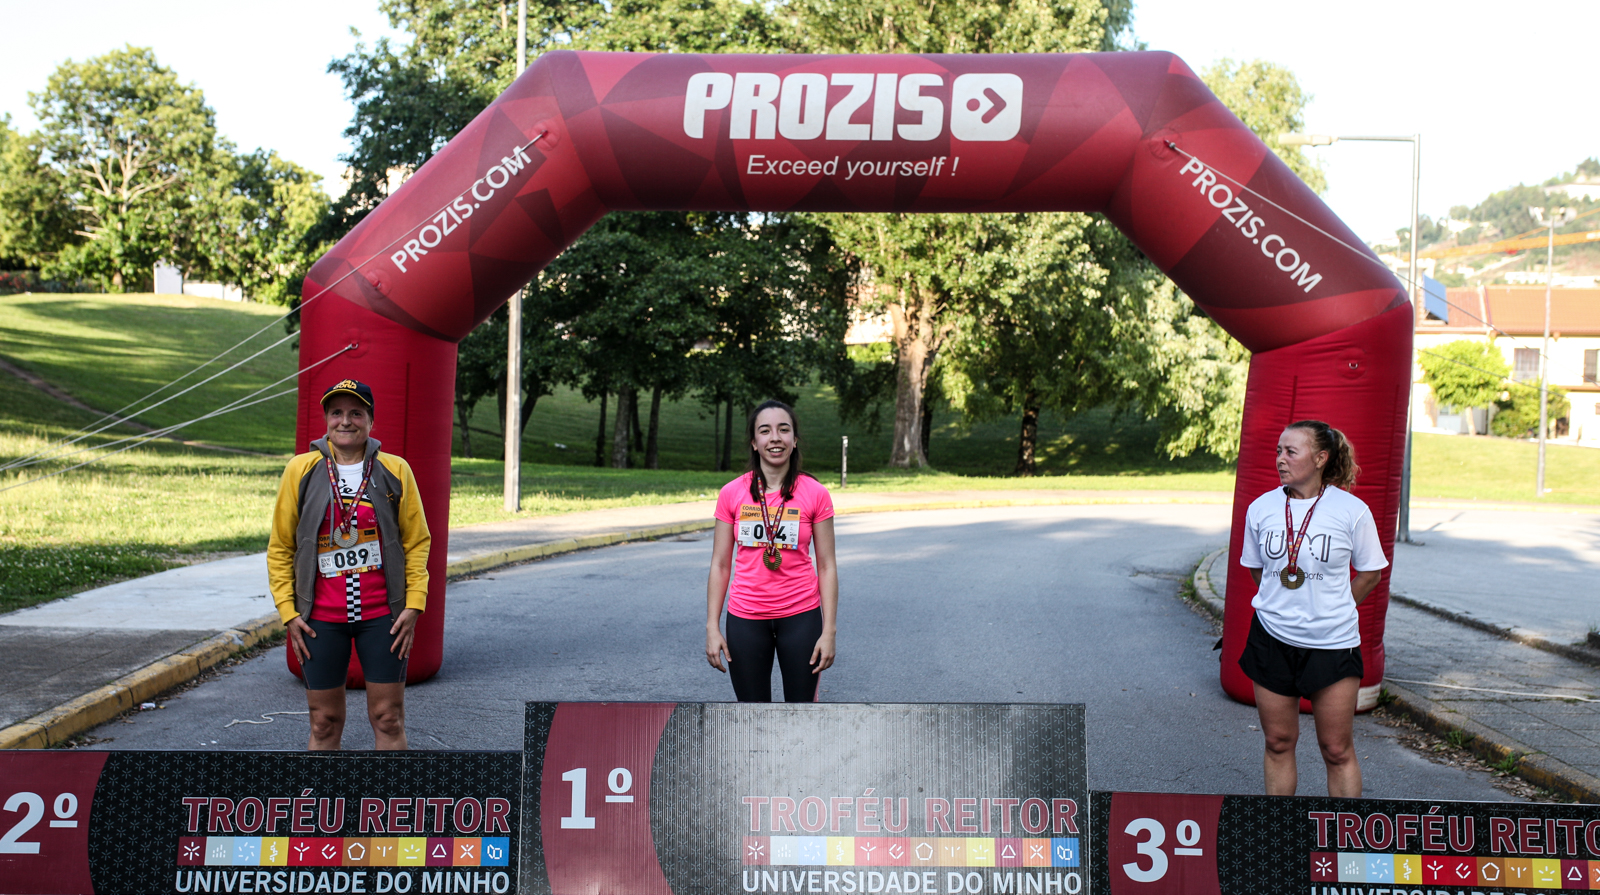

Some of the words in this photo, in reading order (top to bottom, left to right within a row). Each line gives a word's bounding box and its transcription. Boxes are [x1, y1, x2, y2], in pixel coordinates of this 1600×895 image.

[683, 72, 944, 141] PROZIS
[747, 155, 839, 175] Exceed
[844, 157, 945, 180] yourself
[391, 145, 532, 273] PROZIS.COM
[1179, 156, 1323, 293] PROZIS.COM
[754, 524, 786, 541] 04
[334, 548, 369, 568] 089
[182, 788, 346, 833] TROFÉU
[358, 797, 511, 834] REITOR
[741, 787, 909, 833] TROFÉU
[925, 797, 1080, 834] REITOR
[1308, 806, 1475, 852] TROFÉU
[175, 870, 367, 893] UNIVERSIDADE
[376, 871, 412, 894] DO
[421, 871, 510, 894] MINHO
[742, 870, 938, 893] UNIVERSIDADE
[947, 872, 983, 894] DO
[992, 872, 1082, 895] MINHO
